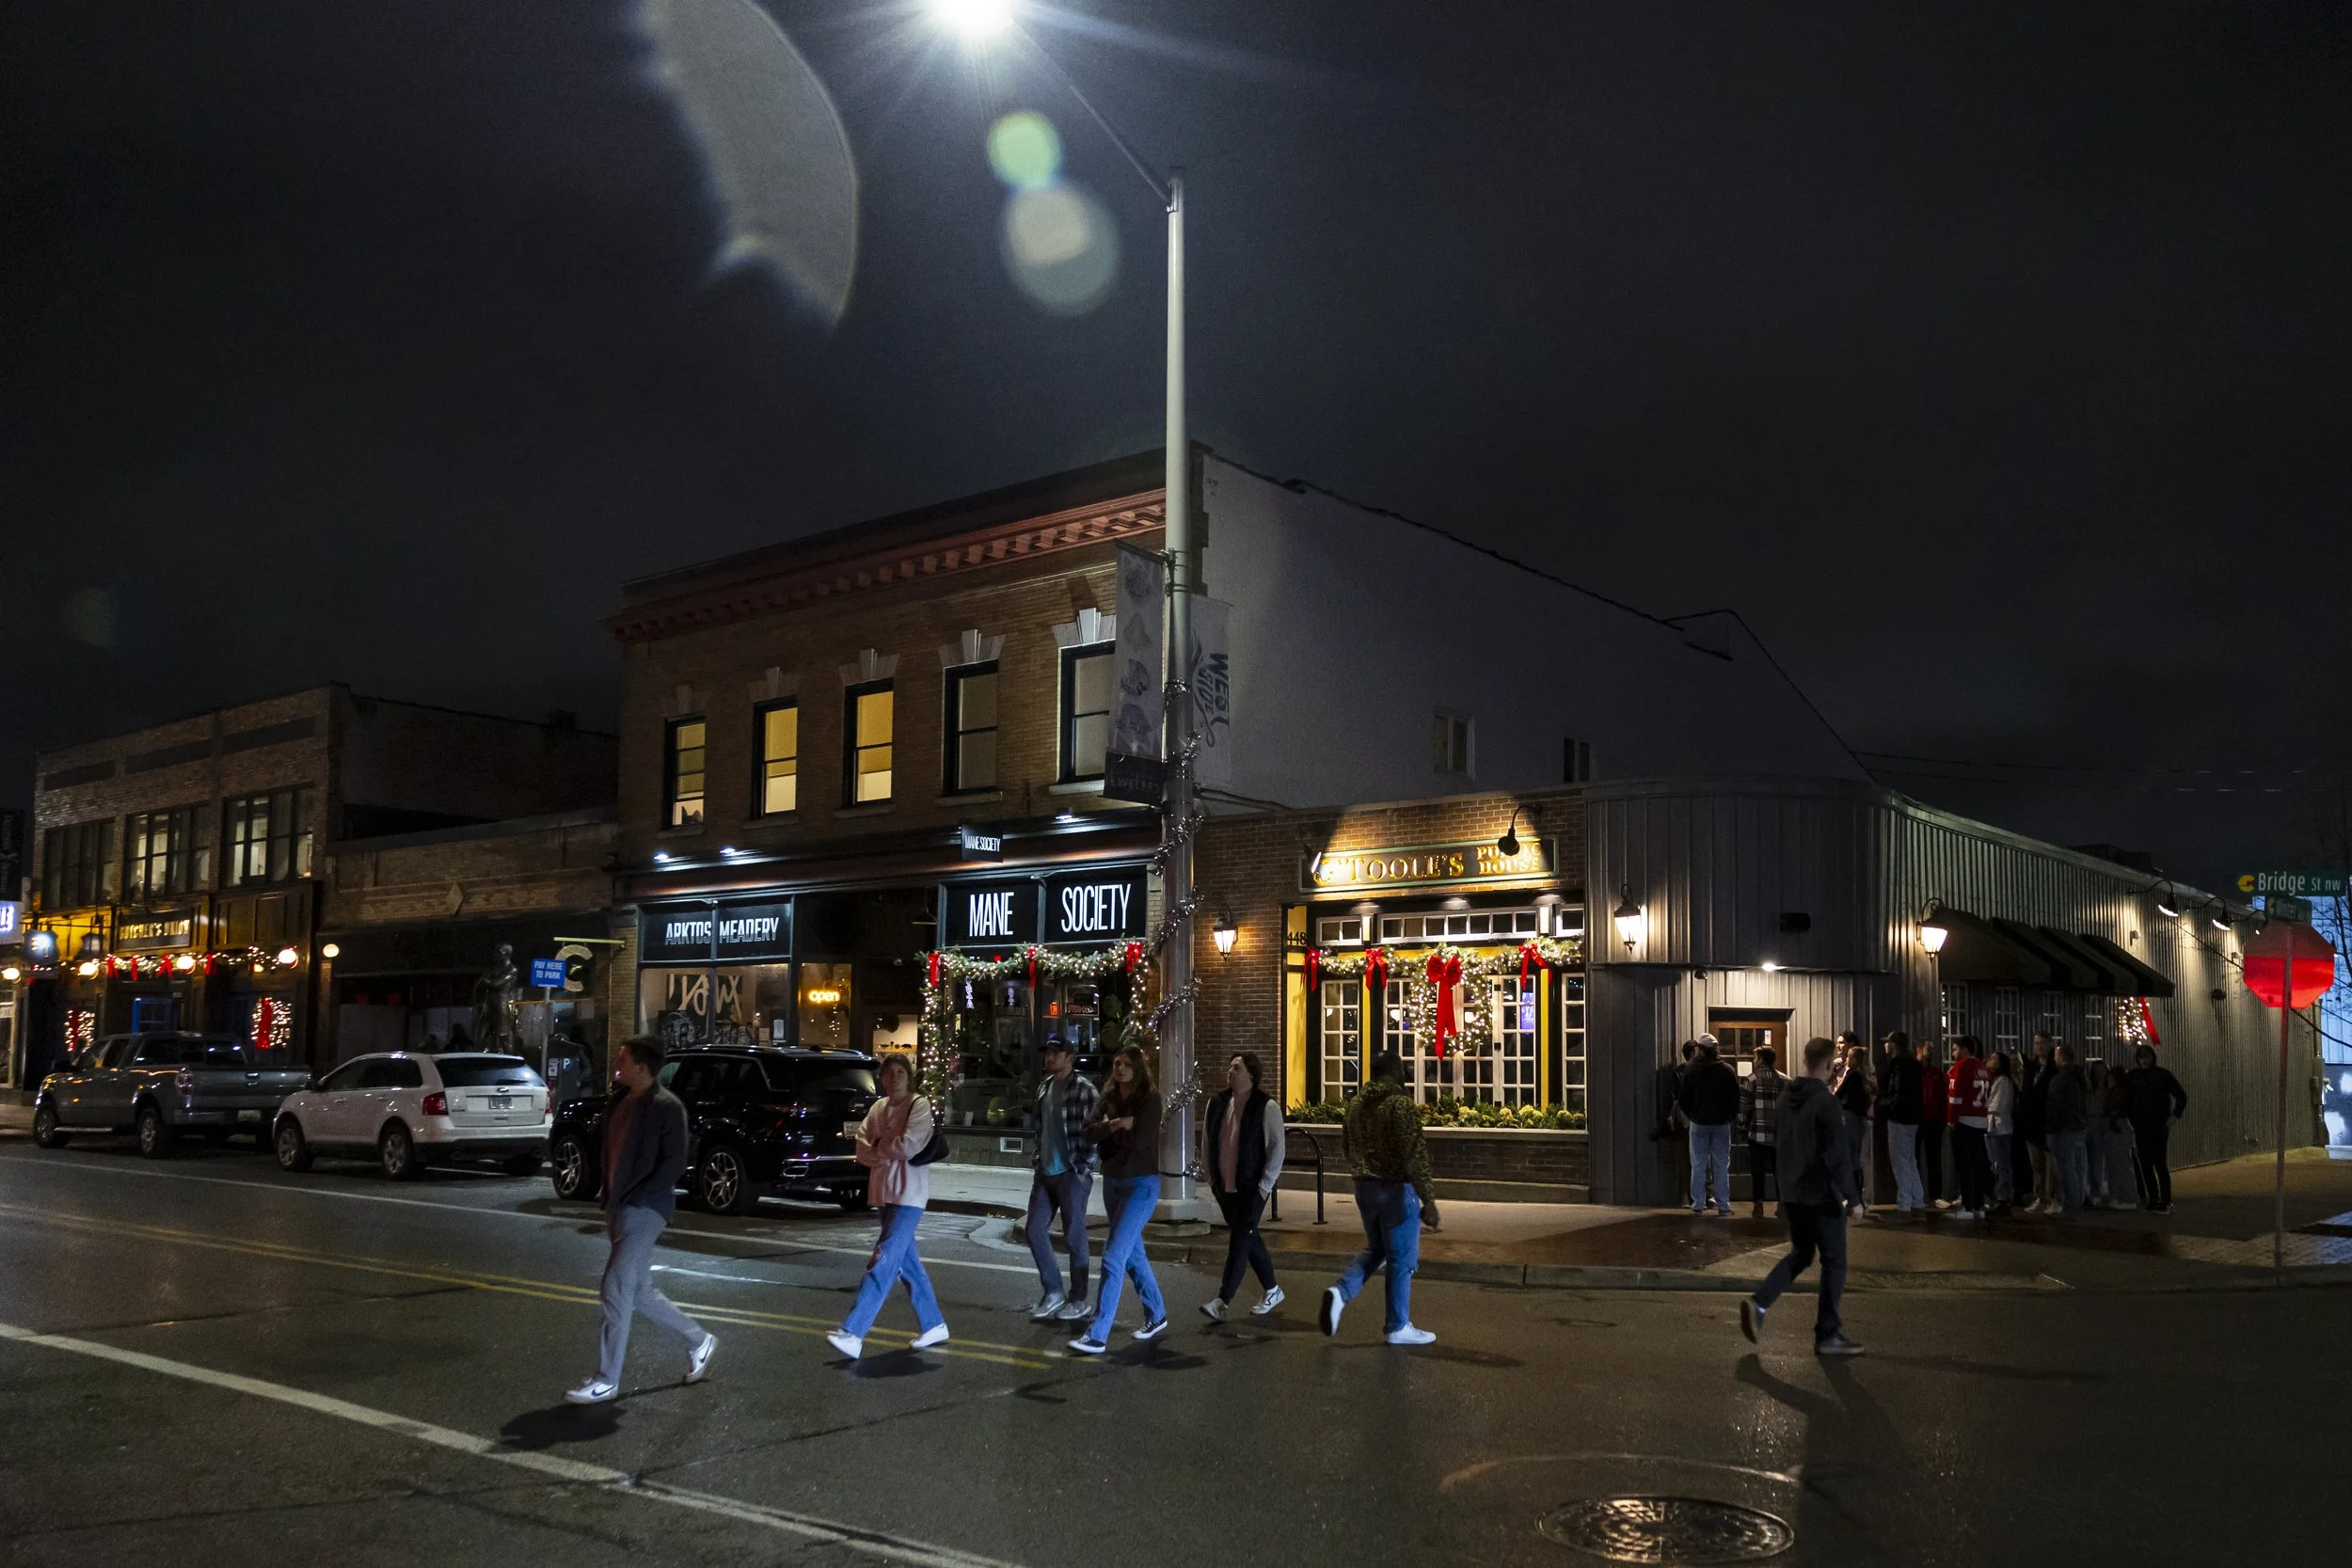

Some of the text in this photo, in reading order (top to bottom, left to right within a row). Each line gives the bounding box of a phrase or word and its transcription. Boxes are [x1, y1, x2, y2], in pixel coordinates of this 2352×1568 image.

[964, 835, 1001, 852] MANE SOCIETY
[2258, 871, 2341, 895] Bridge St nw
[969, 883, 1131, 937] MANE SOCIETY
[664, 916, 780, 945] ARKTOS MEADERY
[1287, 931, 1308, 945] 448
[534, 960, 564, 971] PAY HERE
[535, 970, 561, 979] TO PARK
[808, 990, 840, 1004] open
[563, 1058, 571, 1069] P
